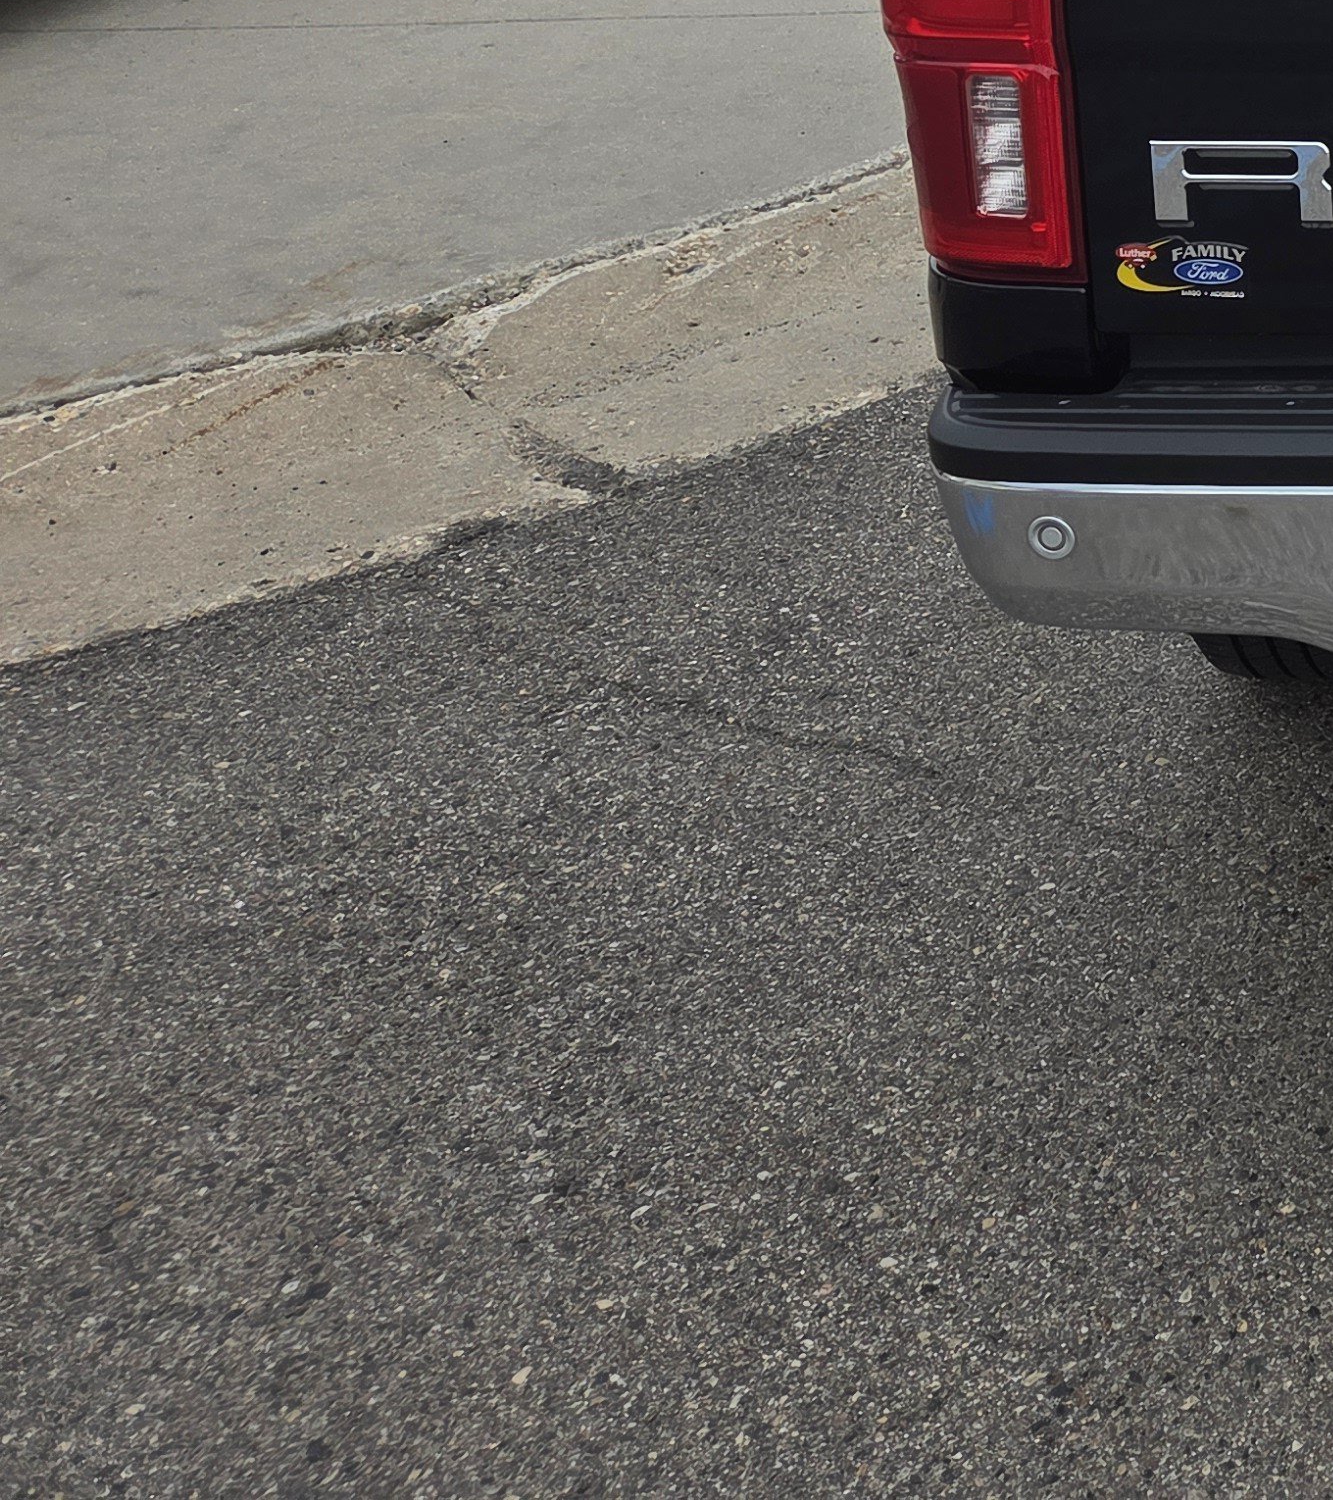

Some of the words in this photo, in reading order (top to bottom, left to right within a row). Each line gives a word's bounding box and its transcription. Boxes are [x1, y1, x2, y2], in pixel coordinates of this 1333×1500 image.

[1118, 247, 1152, 259] Luther
[1171, 244, 1247, 263] FAMILY
[1186, 261, 1229, 281] Ford
